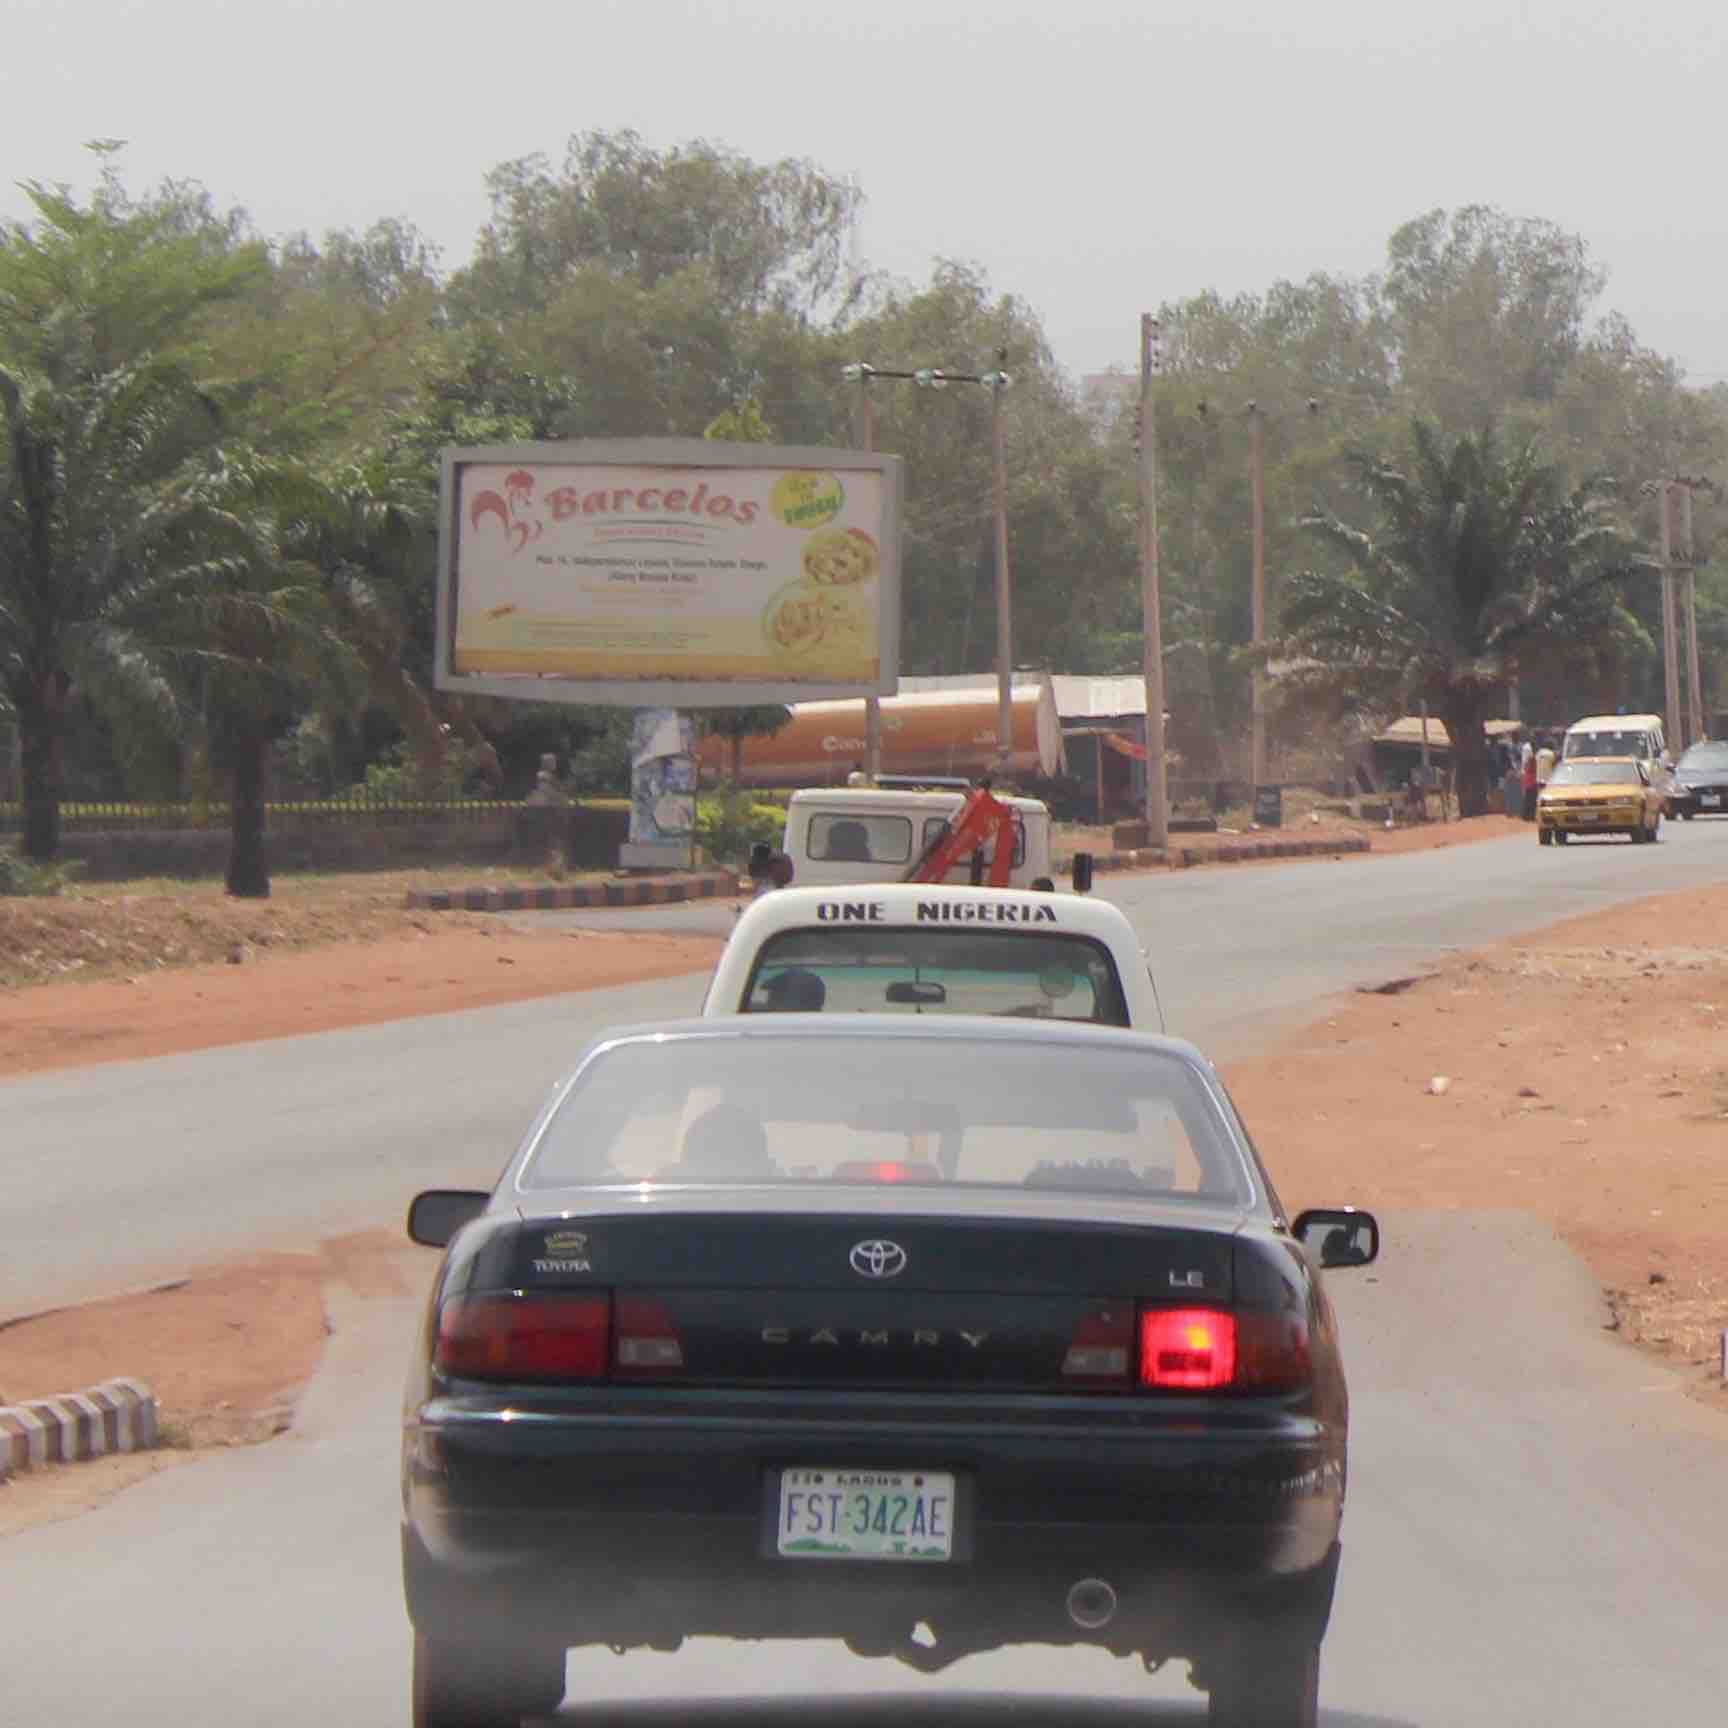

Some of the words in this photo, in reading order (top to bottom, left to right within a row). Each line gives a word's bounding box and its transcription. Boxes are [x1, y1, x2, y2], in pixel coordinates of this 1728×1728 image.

[544, 481, 760, 525] Barcelos
[816, 901, 886, 921] ONE
[916, 901, 1057, 922] NIGERIA
[1168, 1269, 1204, 1288] LE
[761, 1327, 990, 1348] CAMRY
